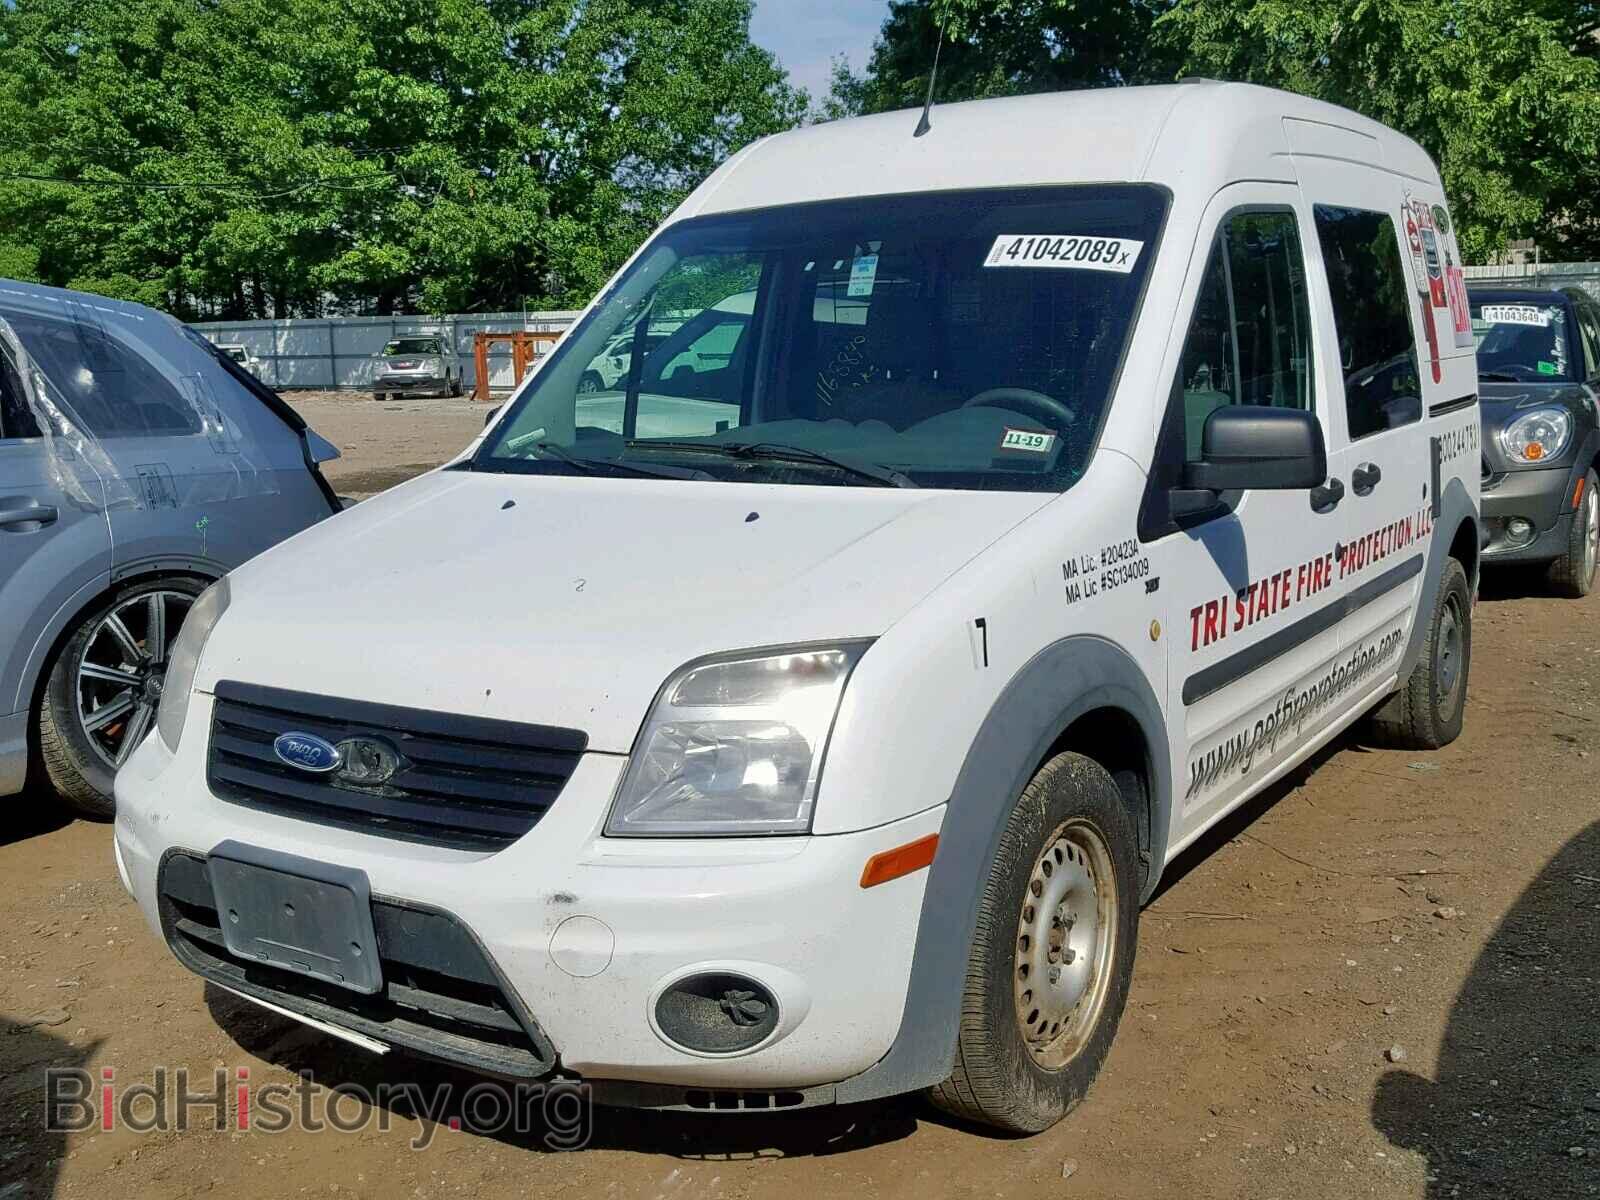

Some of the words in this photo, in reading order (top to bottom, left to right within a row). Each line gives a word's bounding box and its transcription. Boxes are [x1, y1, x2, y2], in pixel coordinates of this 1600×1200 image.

[1006, 433, 1044, 447] 11-19
[1063, 558, 1079, 580] MA
[1081, 554, 1098, 574] Lic.
[1101, 538, 1139, 567] #20423A
[1065, 583, 1081, 605] MA
[1083, 579, 1098, 598] Lic
[1101, 557, 1149, 591] #SC134009
[1190, 597, 1227, 652] TRI
[1234, 569, 1292, 632] STATE
[1297, 552, 1333, 602] FIRE
[1415, 506, 1434, 540] LLC
